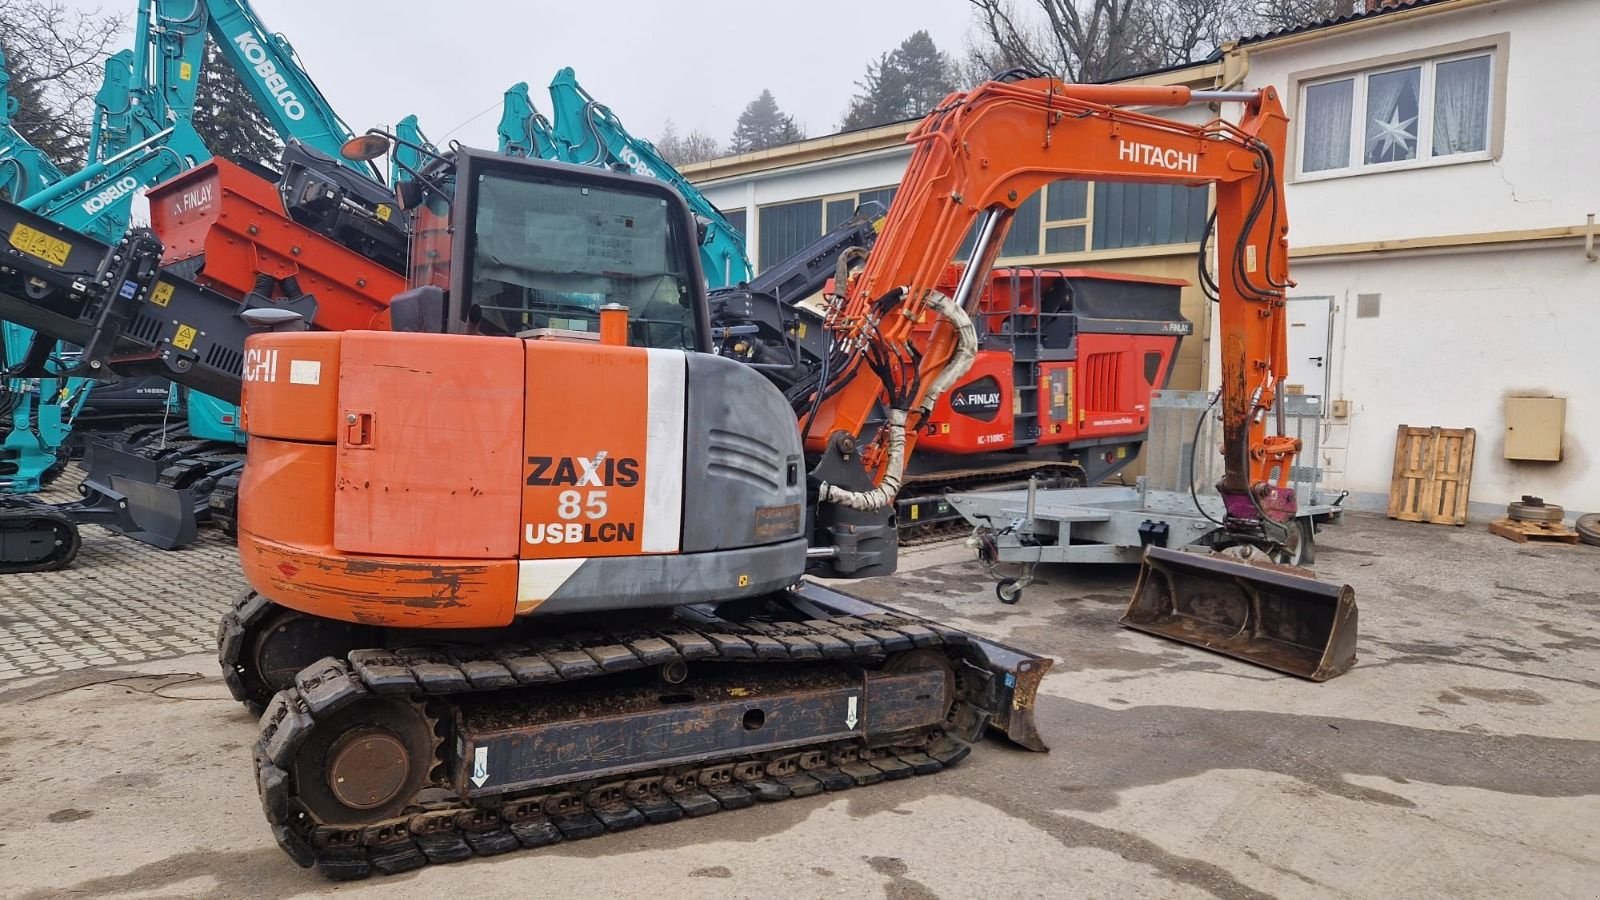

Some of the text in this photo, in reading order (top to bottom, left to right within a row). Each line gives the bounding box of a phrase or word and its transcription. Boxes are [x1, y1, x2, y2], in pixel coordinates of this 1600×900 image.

[234, 31, 305, 120] KOBELCO
[1119, 140, 1198, 173] HITACHI
[81, 176, 137, 215] KOBELCO
[184, 184, 212, 211] FINLAY
[1169, 323, 1189, 332] FINLAY
[968, 393, 1000, 405] FINLAY
[526, 451, 640, 488] ZAXIS
[558, 490, 608, 519] 85
[525, 522, 635, 544] USBLCN
